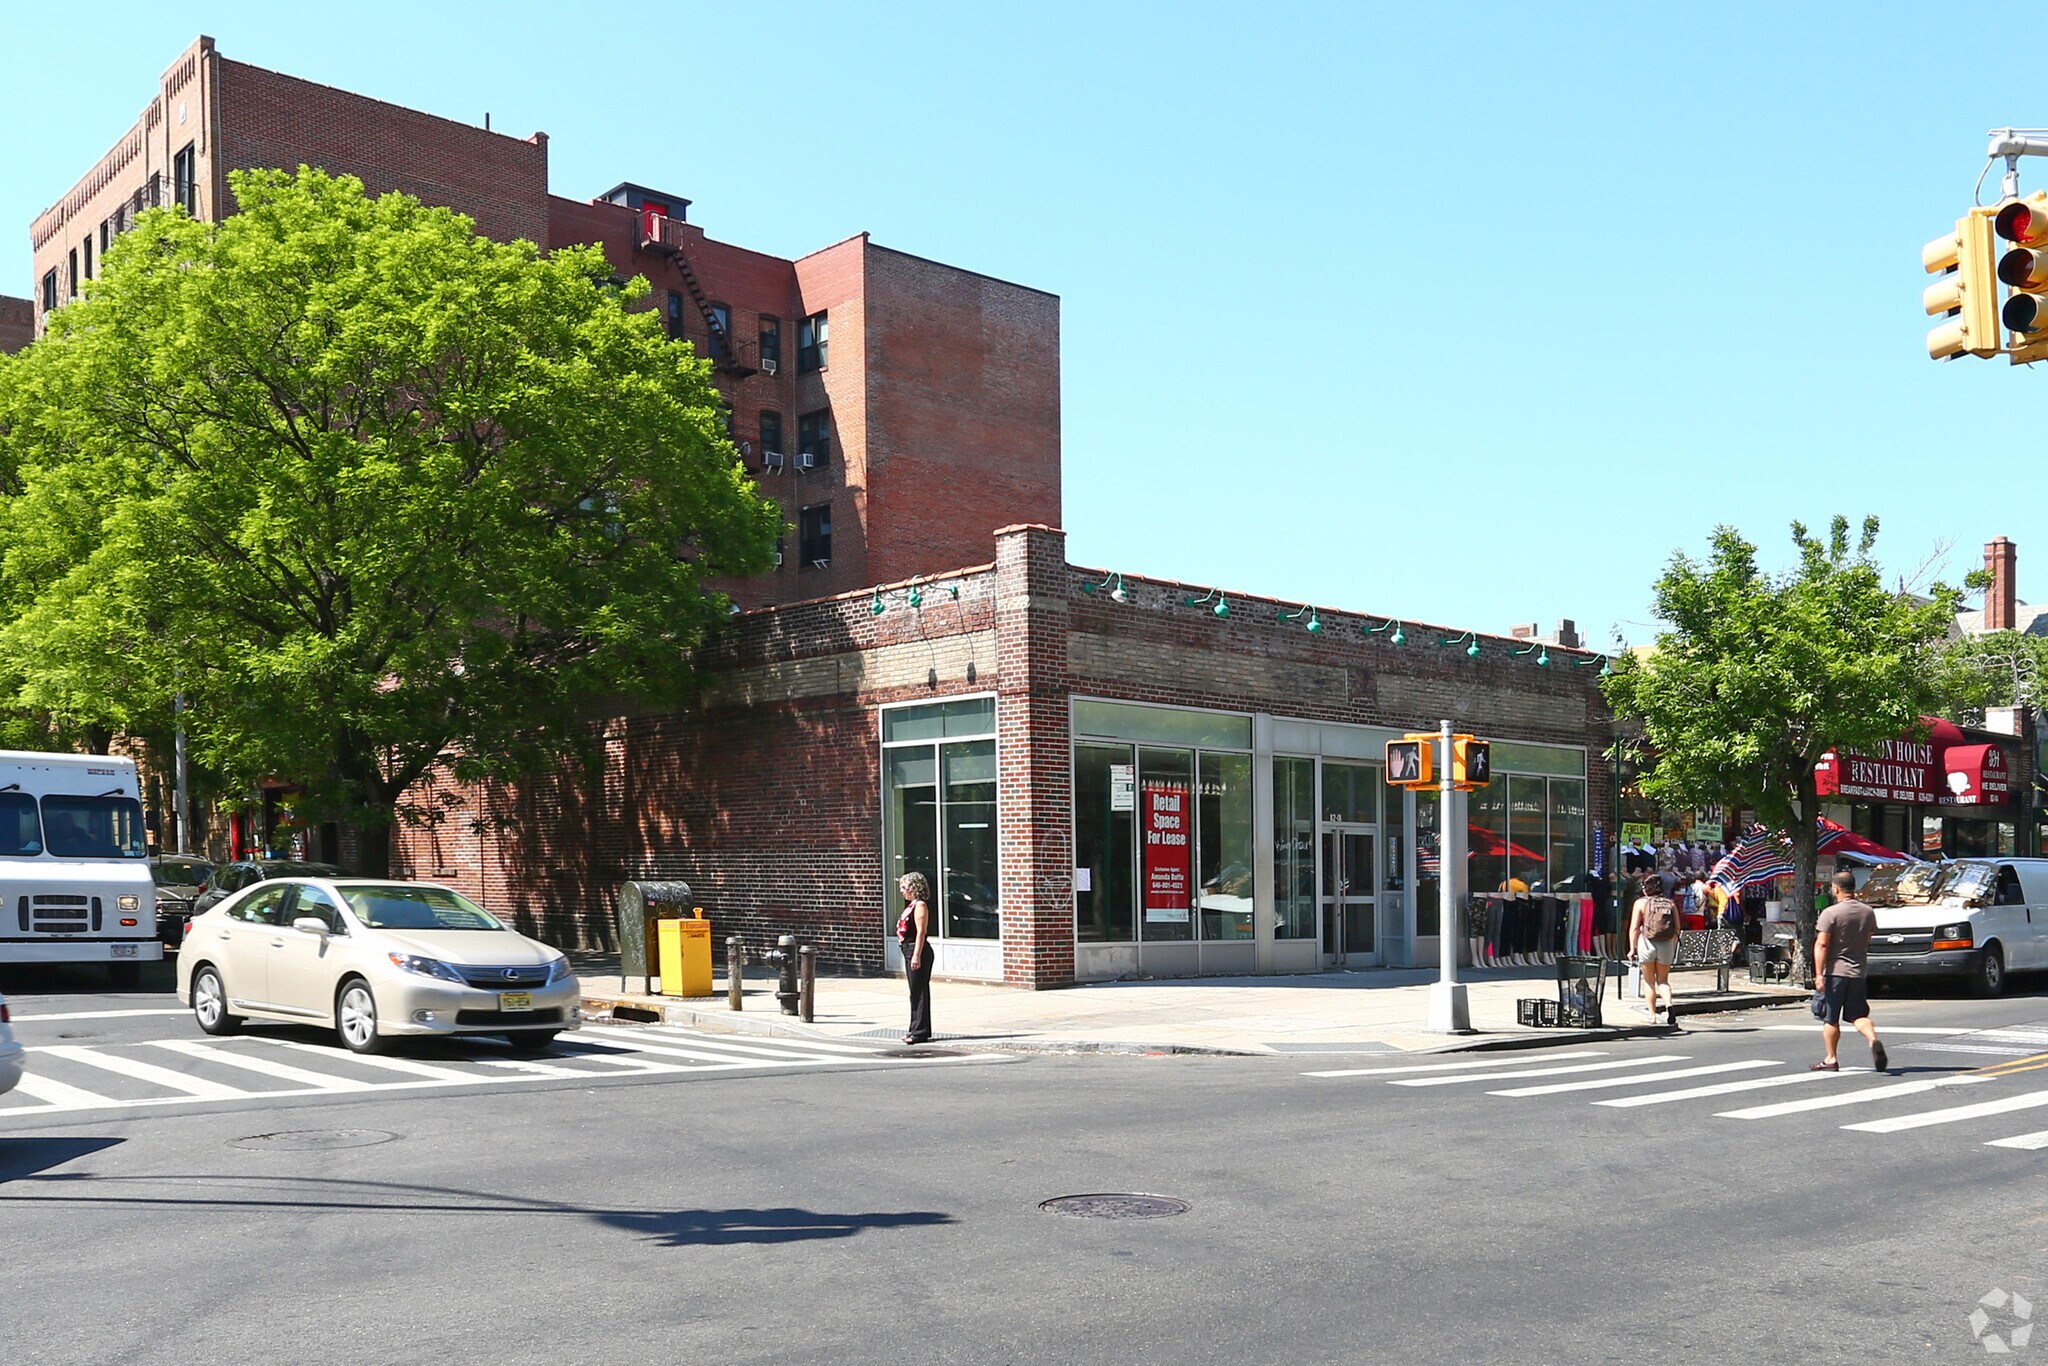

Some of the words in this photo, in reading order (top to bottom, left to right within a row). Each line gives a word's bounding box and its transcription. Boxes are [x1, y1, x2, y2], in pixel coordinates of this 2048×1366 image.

[1896, 741, 1933, 765] HOUSE
[1851, 760, 1925, 789] RESTAURANT
[1153, 794, 1180, 812] Retail
[1153, 812, 1180, 830] Space
[1147, 830, 1161, 844] For
[1162, 830, 1186, 846] Lease
